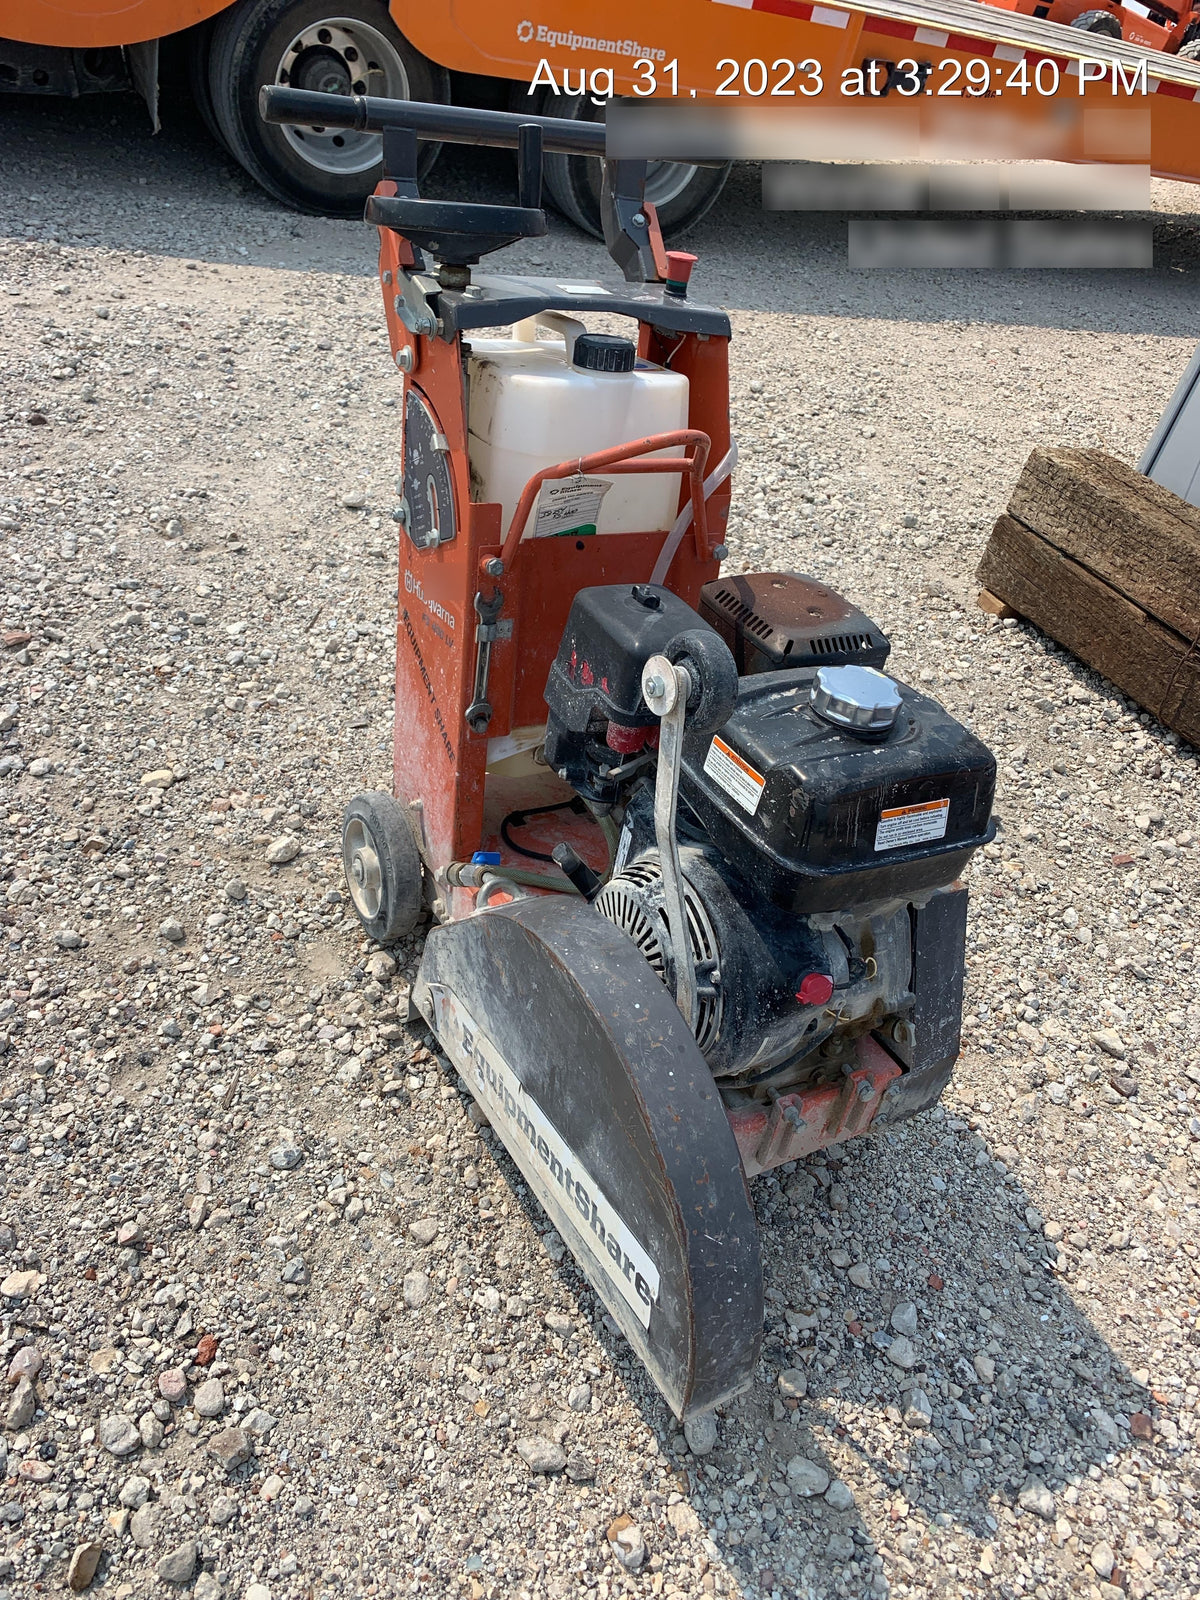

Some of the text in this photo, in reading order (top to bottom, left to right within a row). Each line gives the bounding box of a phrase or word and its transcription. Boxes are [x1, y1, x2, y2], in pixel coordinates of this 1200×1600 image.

[535, 24, 666, 61] EquipmentShare
[413, 578, 456, 629] Huqvarna
[403, 614, 456, 765] EQUIPMENT SHARE
[461, 1022, 651, 1307] EquipmentShare
